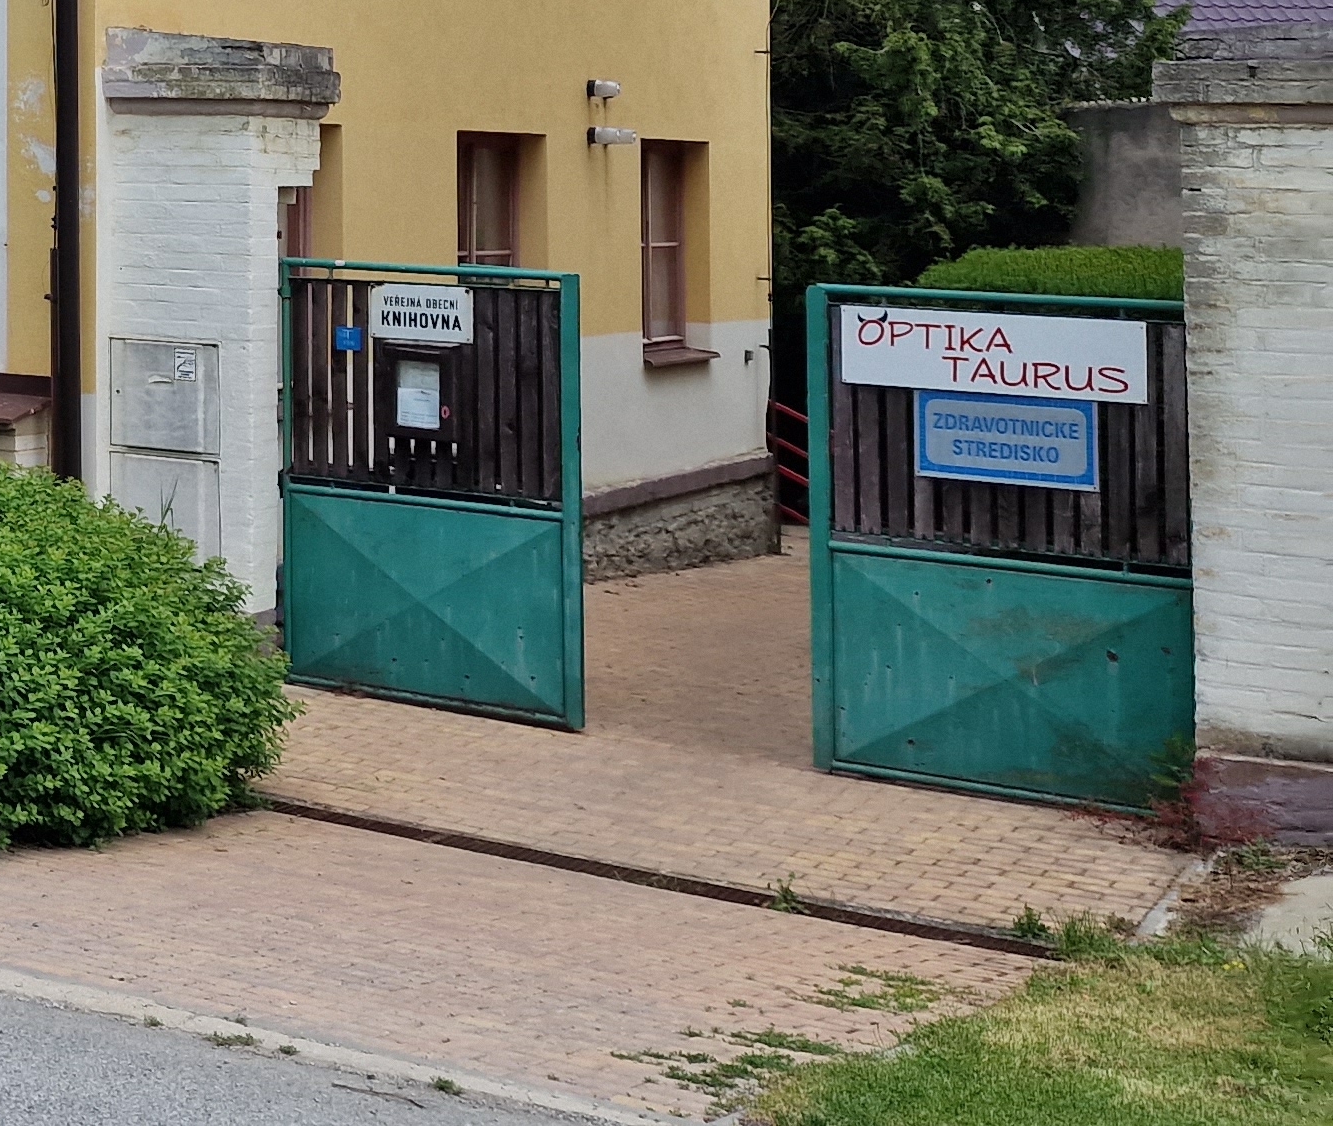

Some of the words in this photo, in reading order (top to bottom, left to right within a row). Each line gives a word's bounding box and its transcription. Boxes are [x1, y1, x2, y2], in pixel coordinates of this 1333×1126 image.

[383, 295, 422, 308] VEŘEJNÁ
[425, 298, 459, 310] OBECNÍ
[381, 310, 462, 331] KNIHOVNA
[858, 319, 1013, 353] OPTIKA
[942, 356, 1129, 393] TAURUS
[933, 412, 1079, 440] ZDRAVOTNICKÉ
